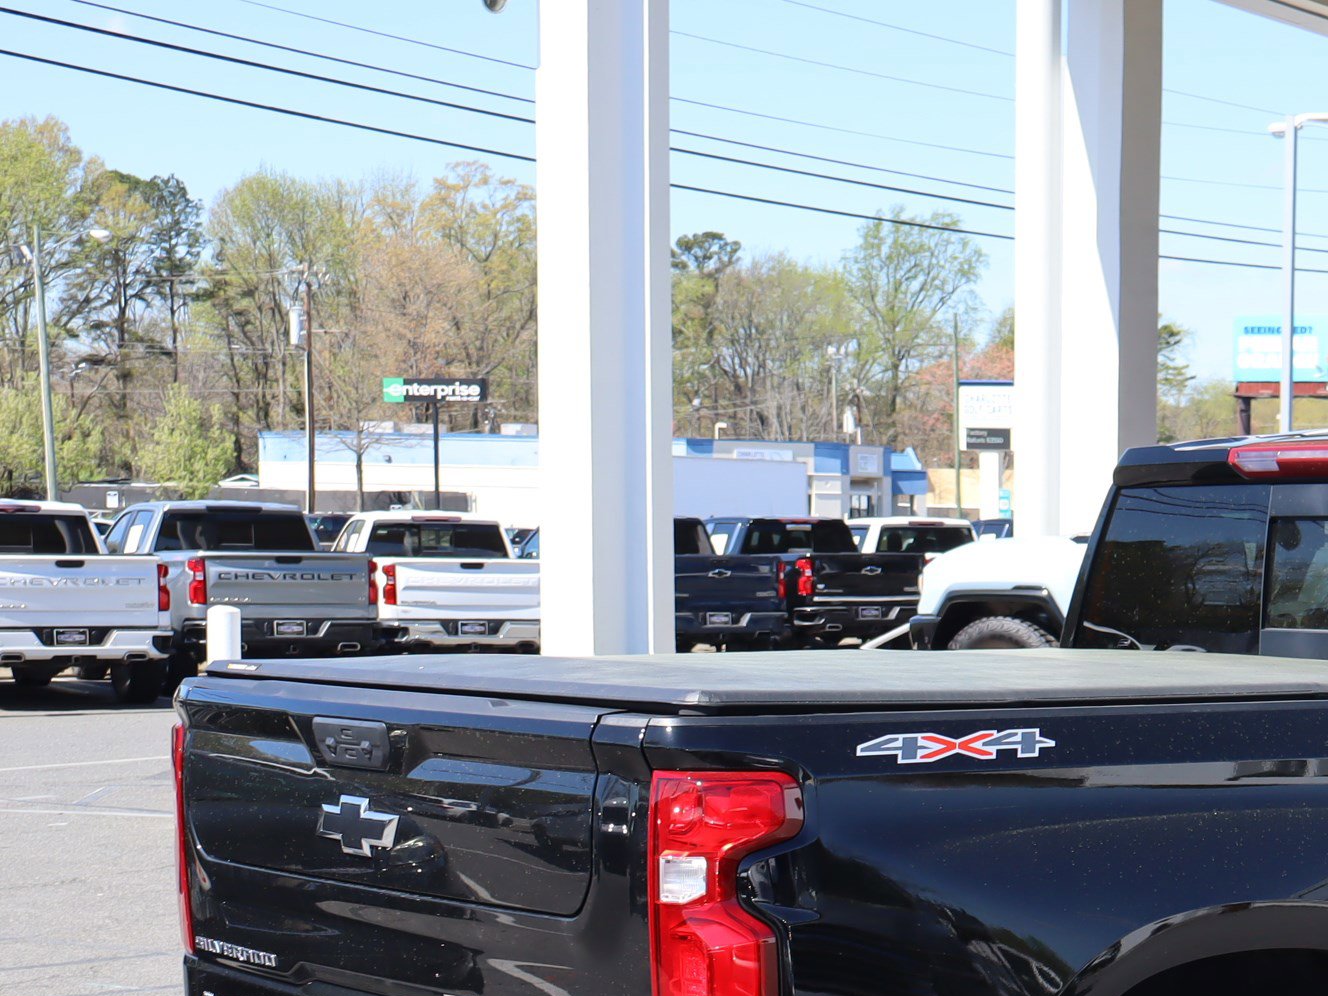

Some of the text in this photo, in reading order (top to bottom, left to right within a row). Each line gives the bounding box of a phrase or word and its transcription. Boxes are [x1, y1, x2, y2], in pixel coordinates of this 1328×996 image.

[384, 381, 481, 400] enterprise
[218, 572, 358, 581] CHEVROLET
[195, 935, 277, 968] SILVERADO
